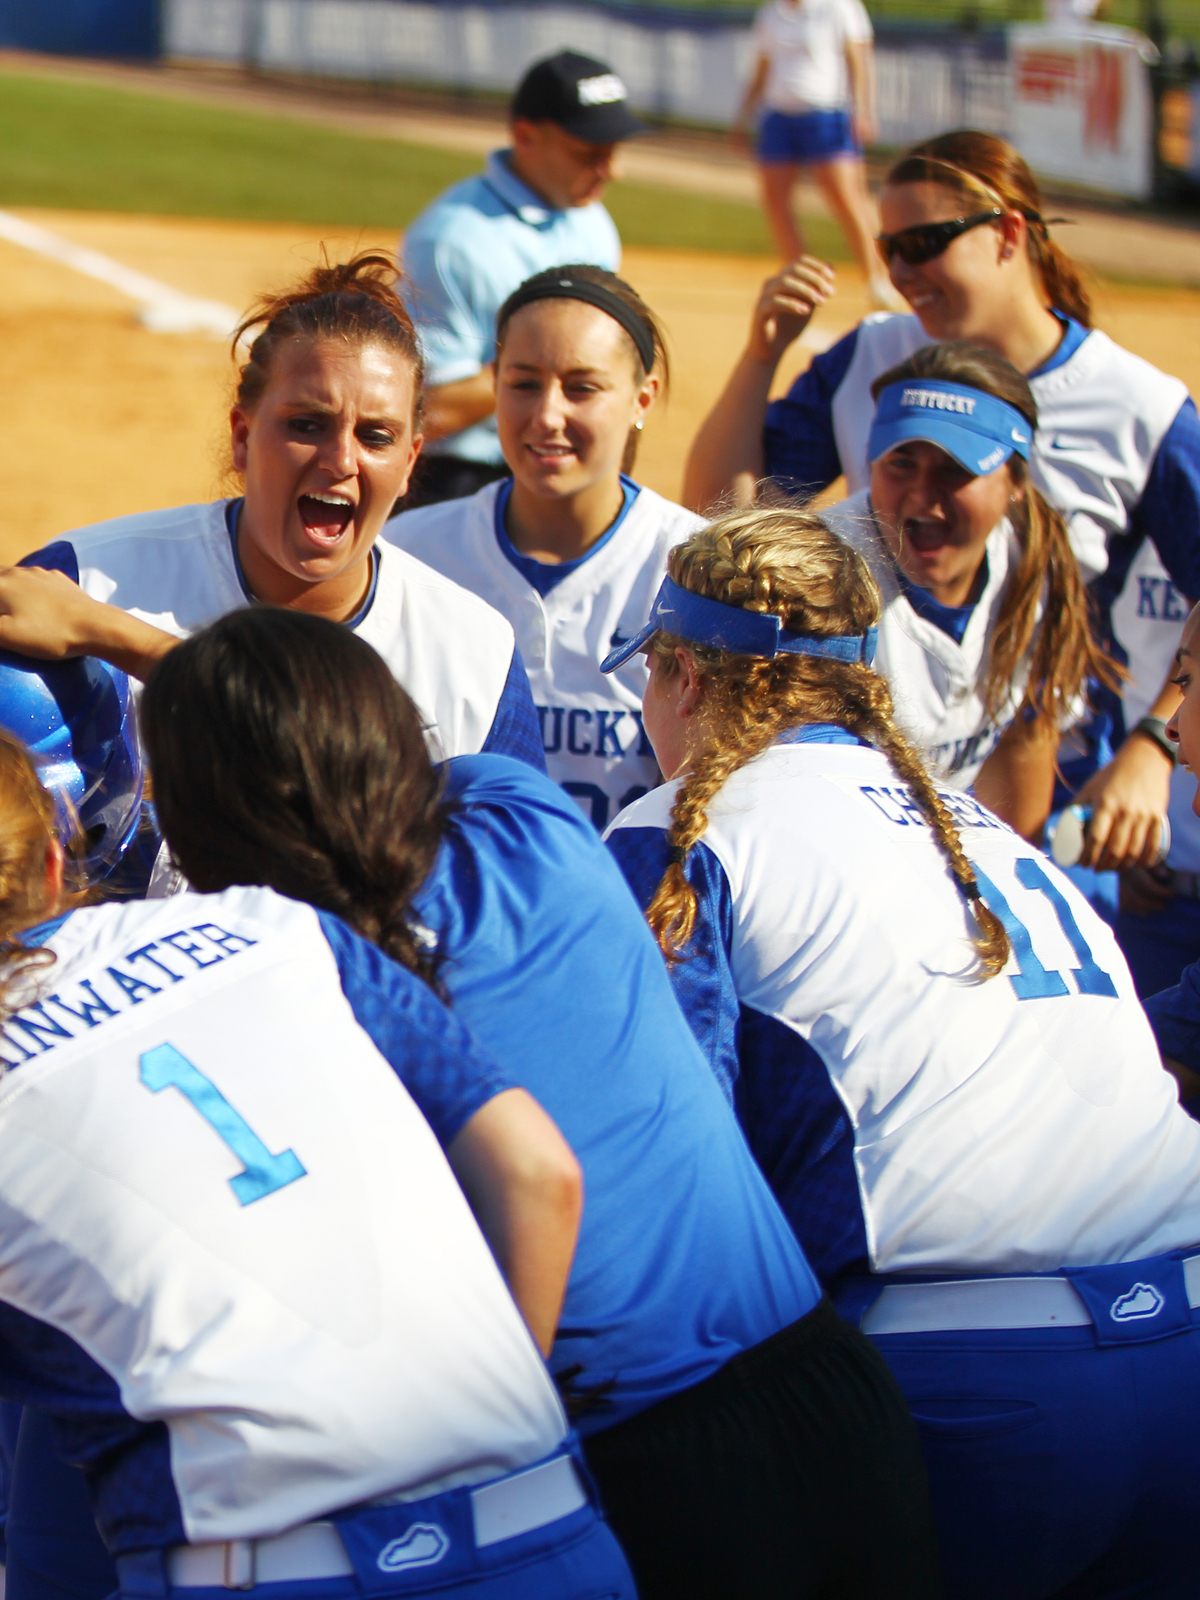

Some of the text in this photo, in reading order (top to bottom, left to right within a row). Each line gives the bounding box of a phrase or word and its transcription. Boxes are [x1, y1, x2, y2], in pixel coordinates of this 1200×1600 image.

[901, 388, 976, 415] KENTUCKY
[859, 786, 1016, 835] CHEK
[968, 858, 1120, 1000] 11
[140, 1042, 307, 1206] 1
